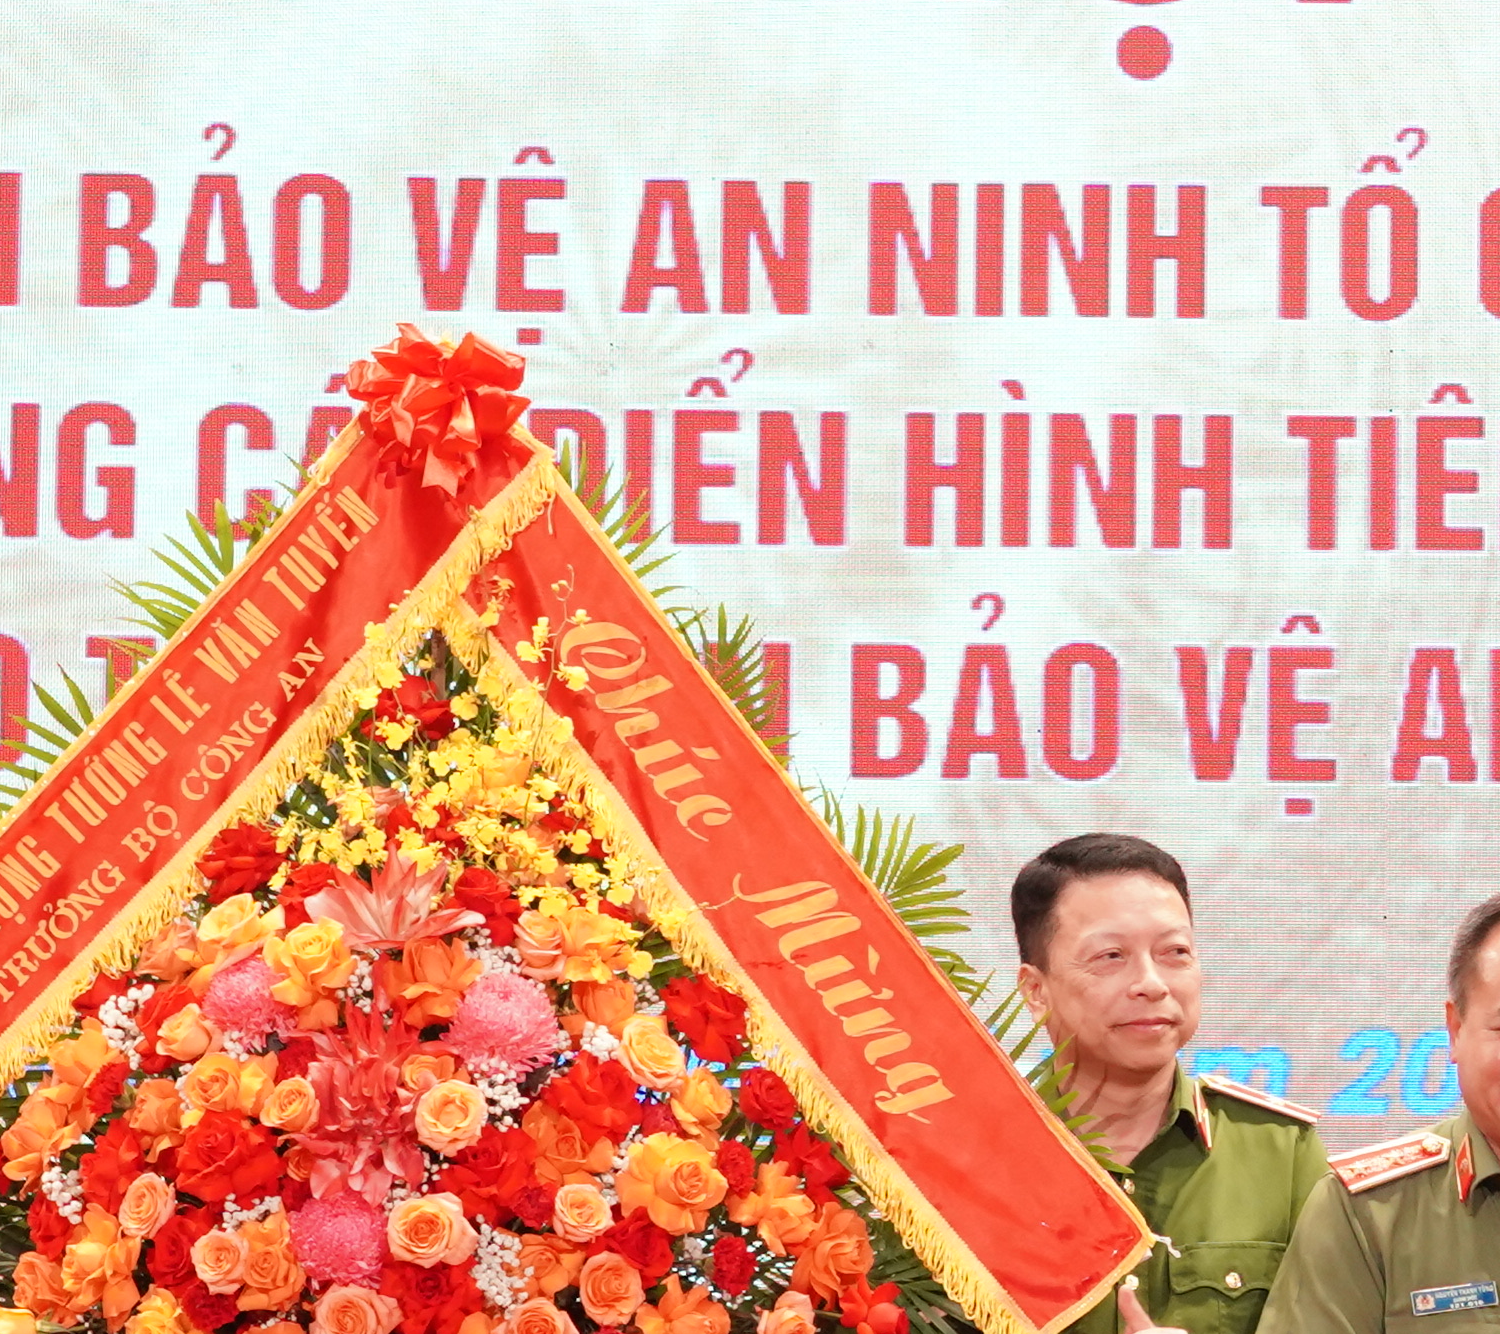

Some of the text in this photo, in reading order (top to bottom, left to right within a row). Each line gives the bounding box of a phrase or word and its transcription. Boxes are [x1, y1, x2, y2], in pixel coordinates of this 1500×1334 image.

[79, 123, 351, 309] BẢO
[410, 148, 566, 344] VỆ
[623, 181, 809, 313] AN
[870, 183, 1204, 317] NINH
[1262, 128, 1428, 321] TỔ
[906, 382, 1232, 548] HÌNH
[43, 721, 168, 844] TƯỚNG
[149, 668, 211, 735] LÊ
[193, 598, 280, 684] VĂN
[262, 485, 379, 611] TUYẾN
[121, 799, 182, 862] BỘ
[180, 701, 277, 802] CÔNG
[278, 637, 326, 702] AN
[852, 595, 1119, 779] BẢO
[1177, 617, 1335, 814] VỆ
[559, 621, 732, 842] Chúc
[733, 872, 956, 1125] Mừng
[1326, 1026, 1462, 1116] 20
